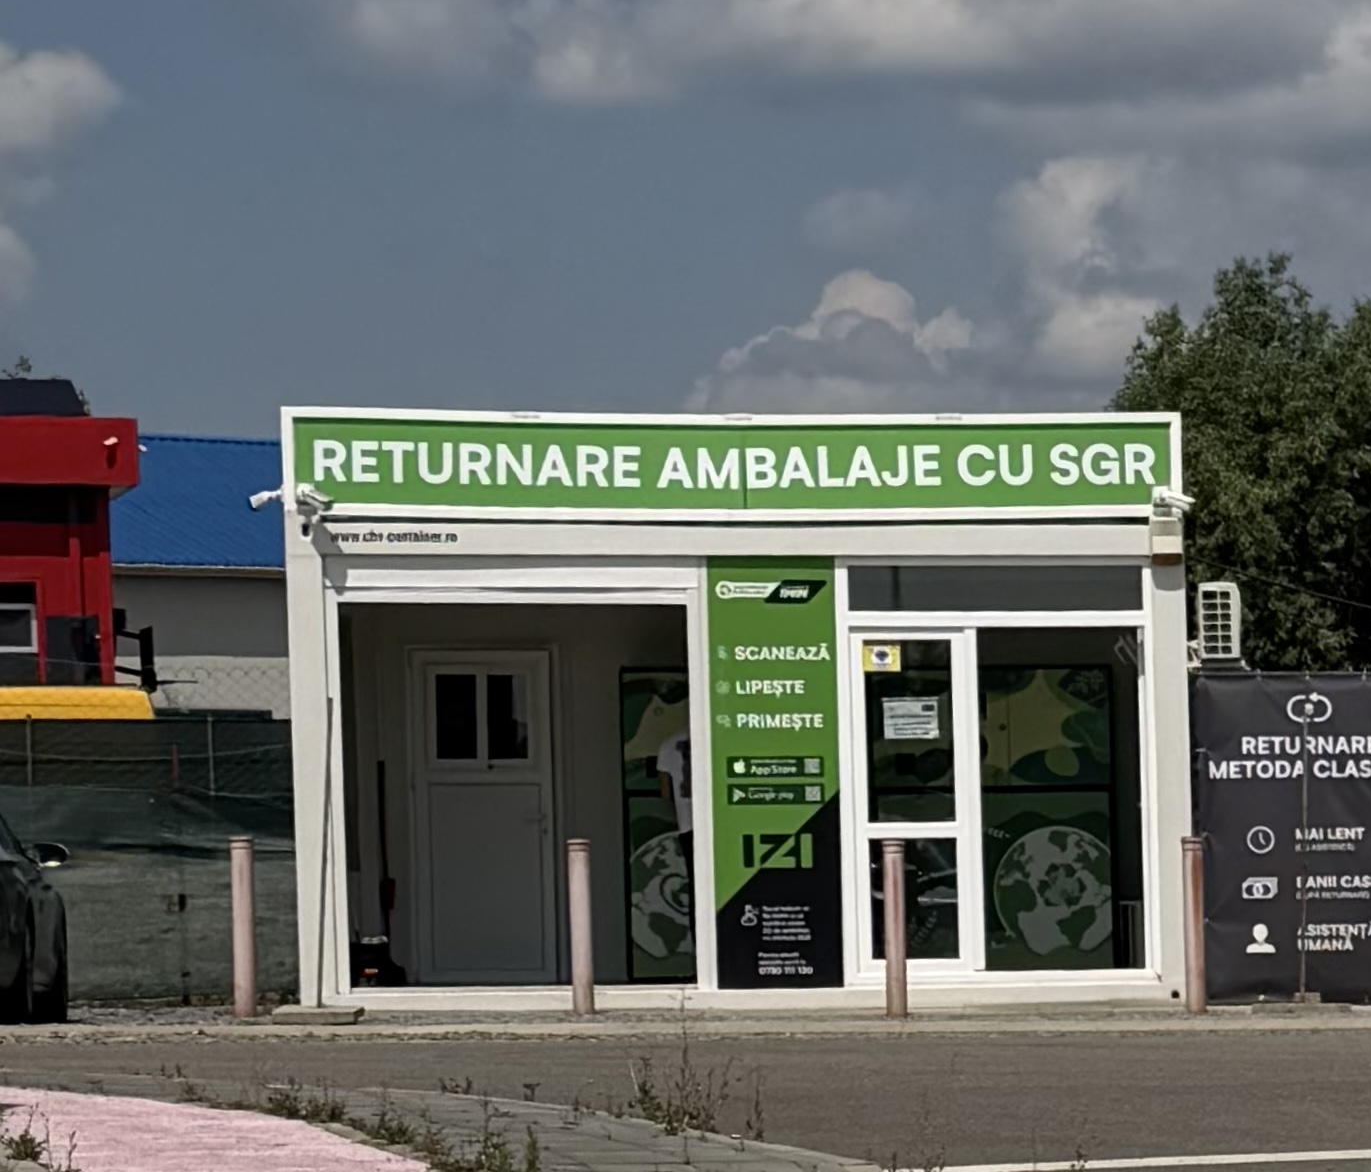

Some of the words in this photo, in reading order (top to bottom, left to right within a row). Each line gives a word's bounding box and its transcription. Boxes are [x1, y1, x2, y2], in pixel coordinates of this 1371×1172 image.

[313, 439, 641, 488] RETURNARE
[656, 445, 942, 489] AMBALAJE
[957, 444, 1034, 486] CU
[1049, 443, 1156, 486] SGR
[734, 643, 831, 660] SCANEAZĂ
[736, 680, 805, 698] LIPEȘTE
[737, 713, 824, 731] PRIMEȘTE
[1208, 760, 1304, 779] METODA
[1327, 827, 1365, 840] LENT
[742, 833, 813, 868] IZI
